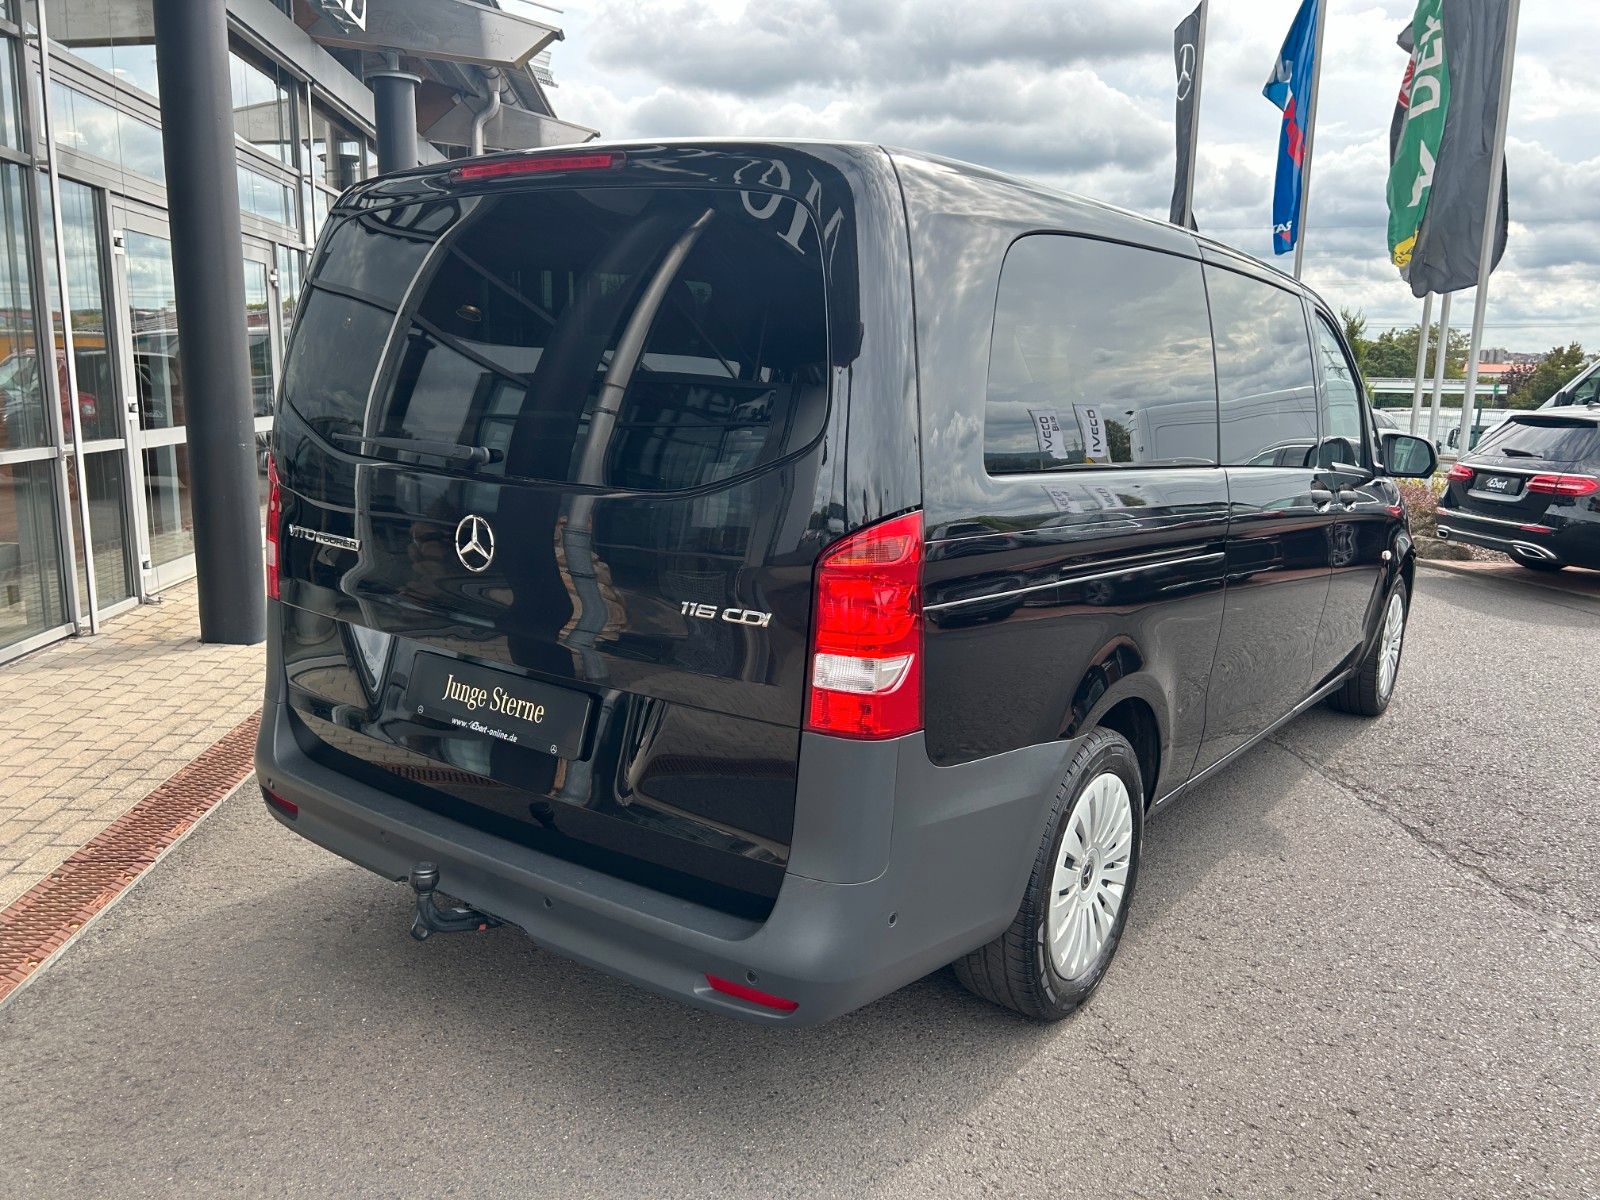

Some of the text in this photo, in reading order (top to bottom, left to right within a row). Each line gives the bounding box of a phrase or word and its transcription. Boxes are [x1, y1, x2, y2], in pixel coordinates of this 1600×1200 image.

[1408, 6, 1442, 120] DEK
[1039, 416, 1053, 453] IVECO
[1087, 409, 1101, 453] IVECO
[681, 601, 772, 628] 116 CDI
[442, 673, 545, 724] Junge Sterne
